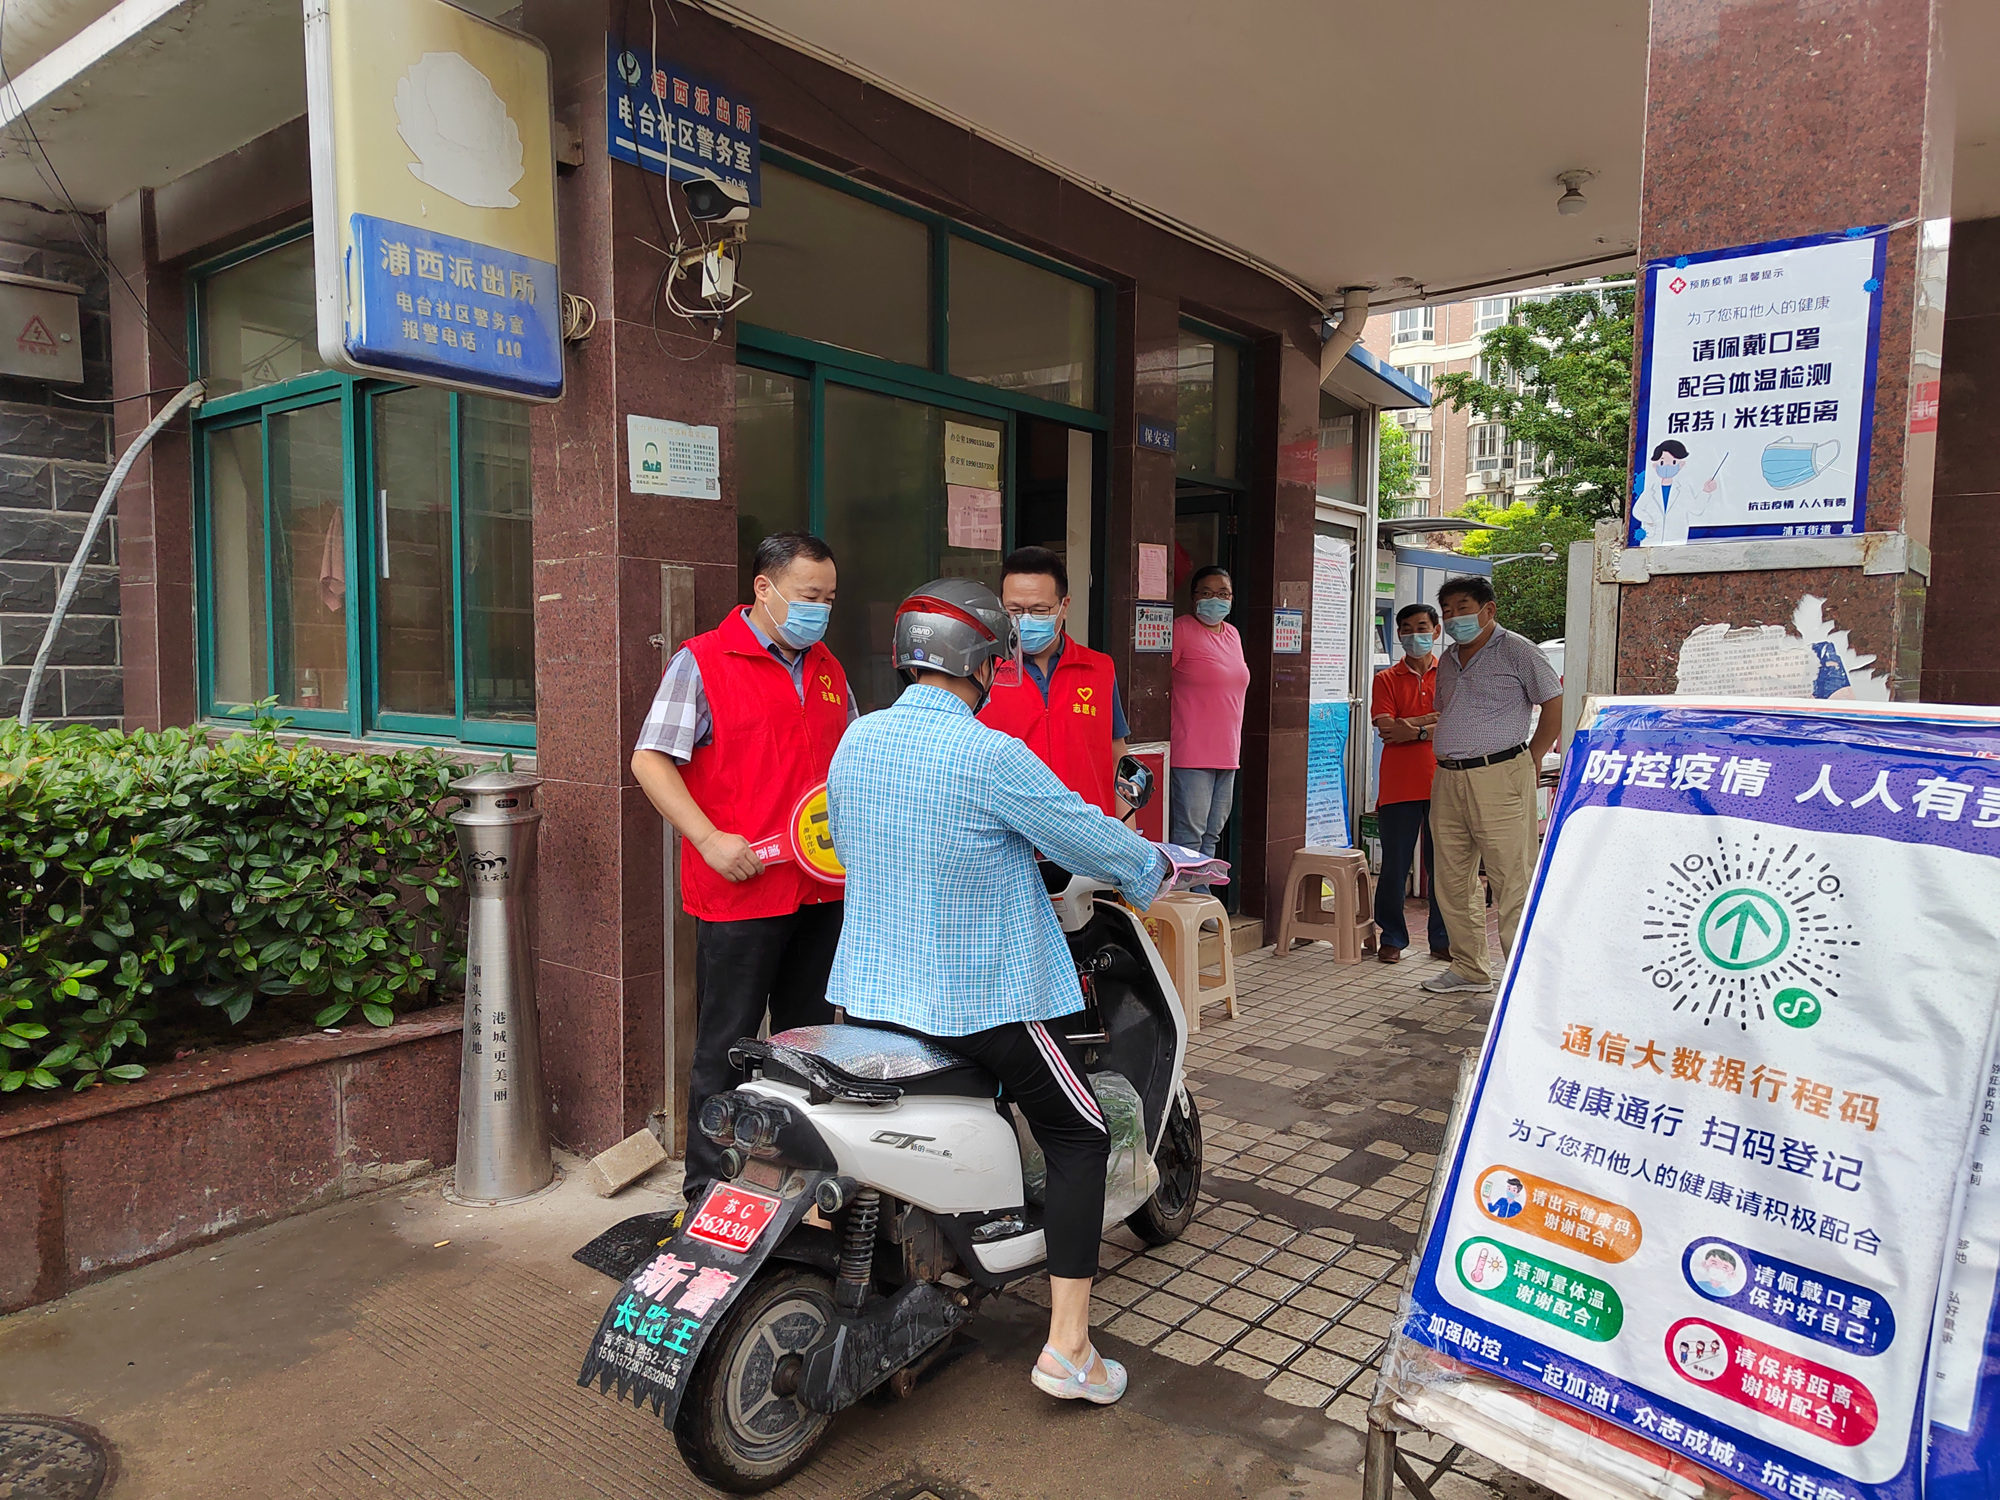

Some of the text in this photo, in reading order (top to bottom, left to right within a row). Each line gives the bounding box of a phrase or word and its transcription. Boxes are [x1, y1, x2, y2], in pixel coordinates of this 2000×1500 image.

[651, 69, 752, 133] 浦西派出所
[618, 94, 752, 174] 电台社区警务室
[379, 238, 536, 305] 浦西派出所
[1689, 268, 1784, 290] 预防疫情 温馨提示
[396, 291, 525, 336] 电台社区警务室
[1687, 295, 1831, 326] 为了您和他人的健康
[402, 319, 477, 352] 报警电话
[1692, 327, 1820, 362] 请佩戴口罩
[1677, 362, 1832, 399] 配合体温检测
[1144, 427, 1171, 447] 保安室
[1748, 497, 1847, 511] 抗击疫情 人人有责
[1782, 524, 1832, 536] 浦西街道
[1580, 749, 1773, 798] 防控疫情
[470, 964, 483, 1055] 烟头不落地
[491, 1010, 508, 1102] 港城更美丽
[1560, 1023, 1881, 1132] 通信大数据行程码
[1547, 1076, 1864, 1193] 健康通行 扫码登记
[1508, 1117, 1884, 1256] 为了您和他人的健康请积极配合
[693, 1213, 757, 1244] 562830A
[613, 1293, 700, 1355] 长跑王
